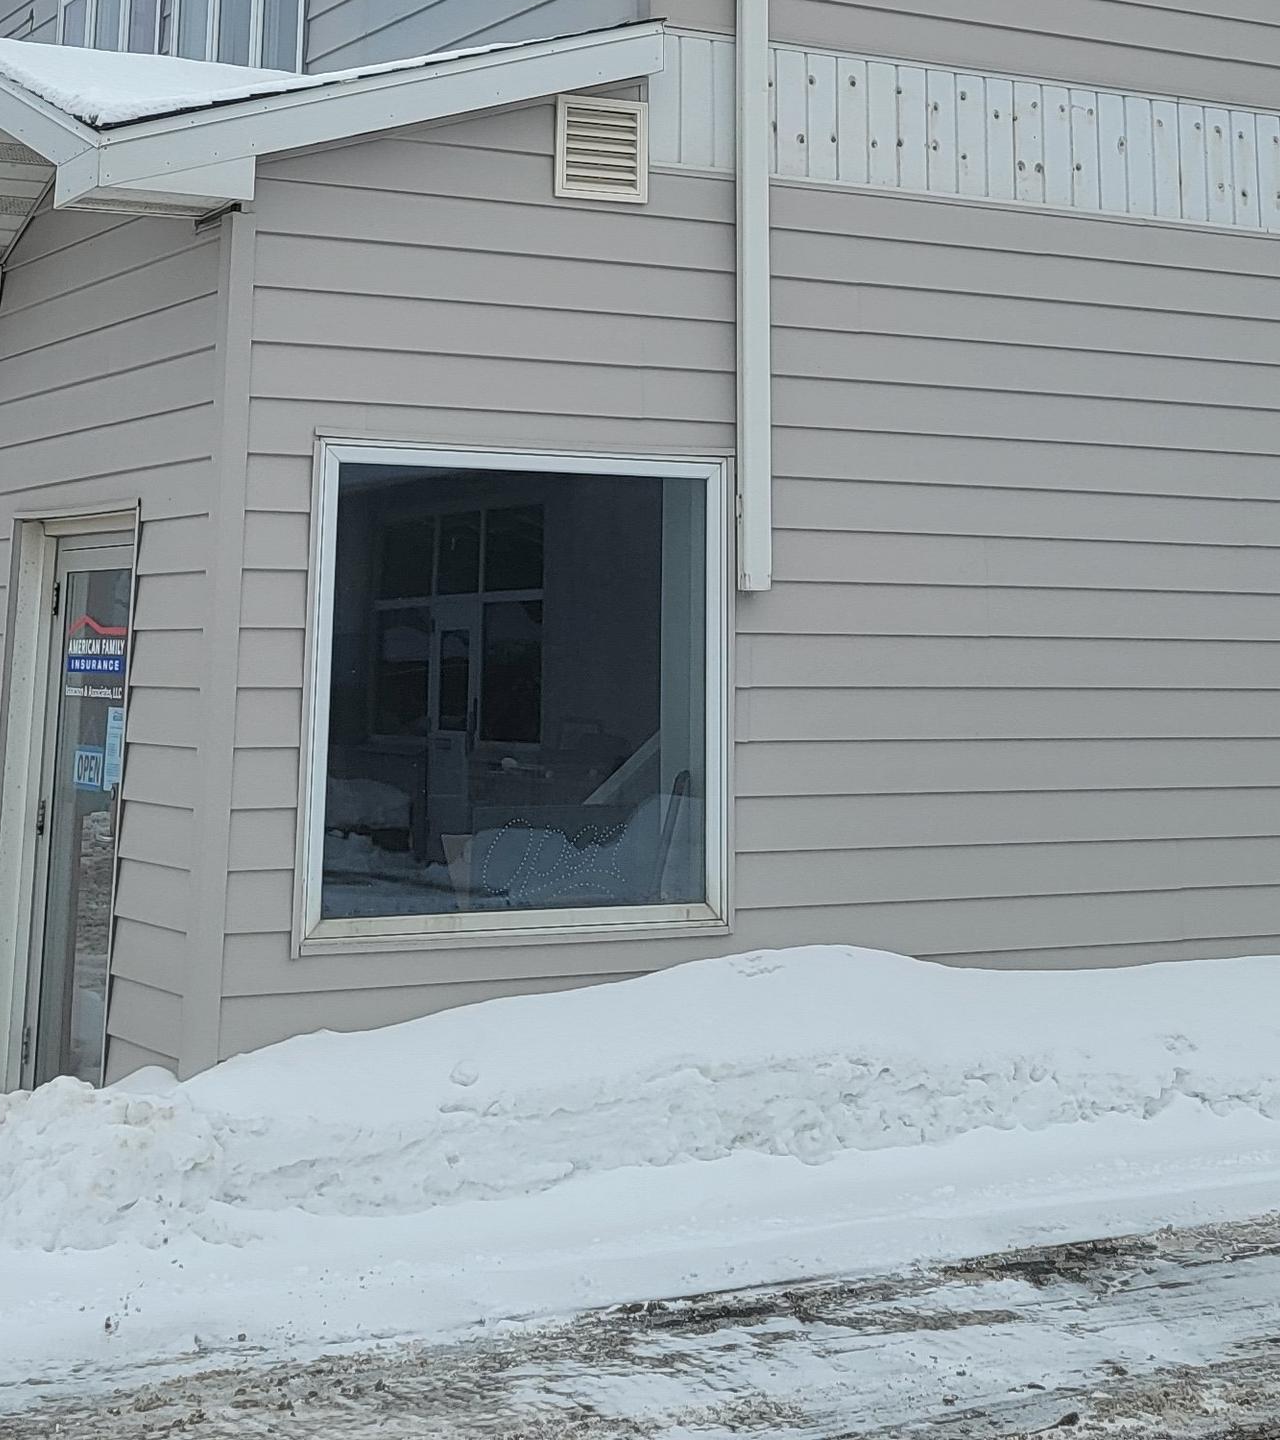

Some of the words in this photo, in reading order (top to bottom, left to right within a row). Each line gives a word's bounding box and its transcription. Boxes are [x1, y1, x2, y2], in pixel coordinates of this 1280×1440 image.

[69, 639, 100, 655] AMERICAN
[101, 639, 125, 655] FAMILY
[71, 659, 120, 671] INSURANCE
[77, 754, 100, 784] OPEN
